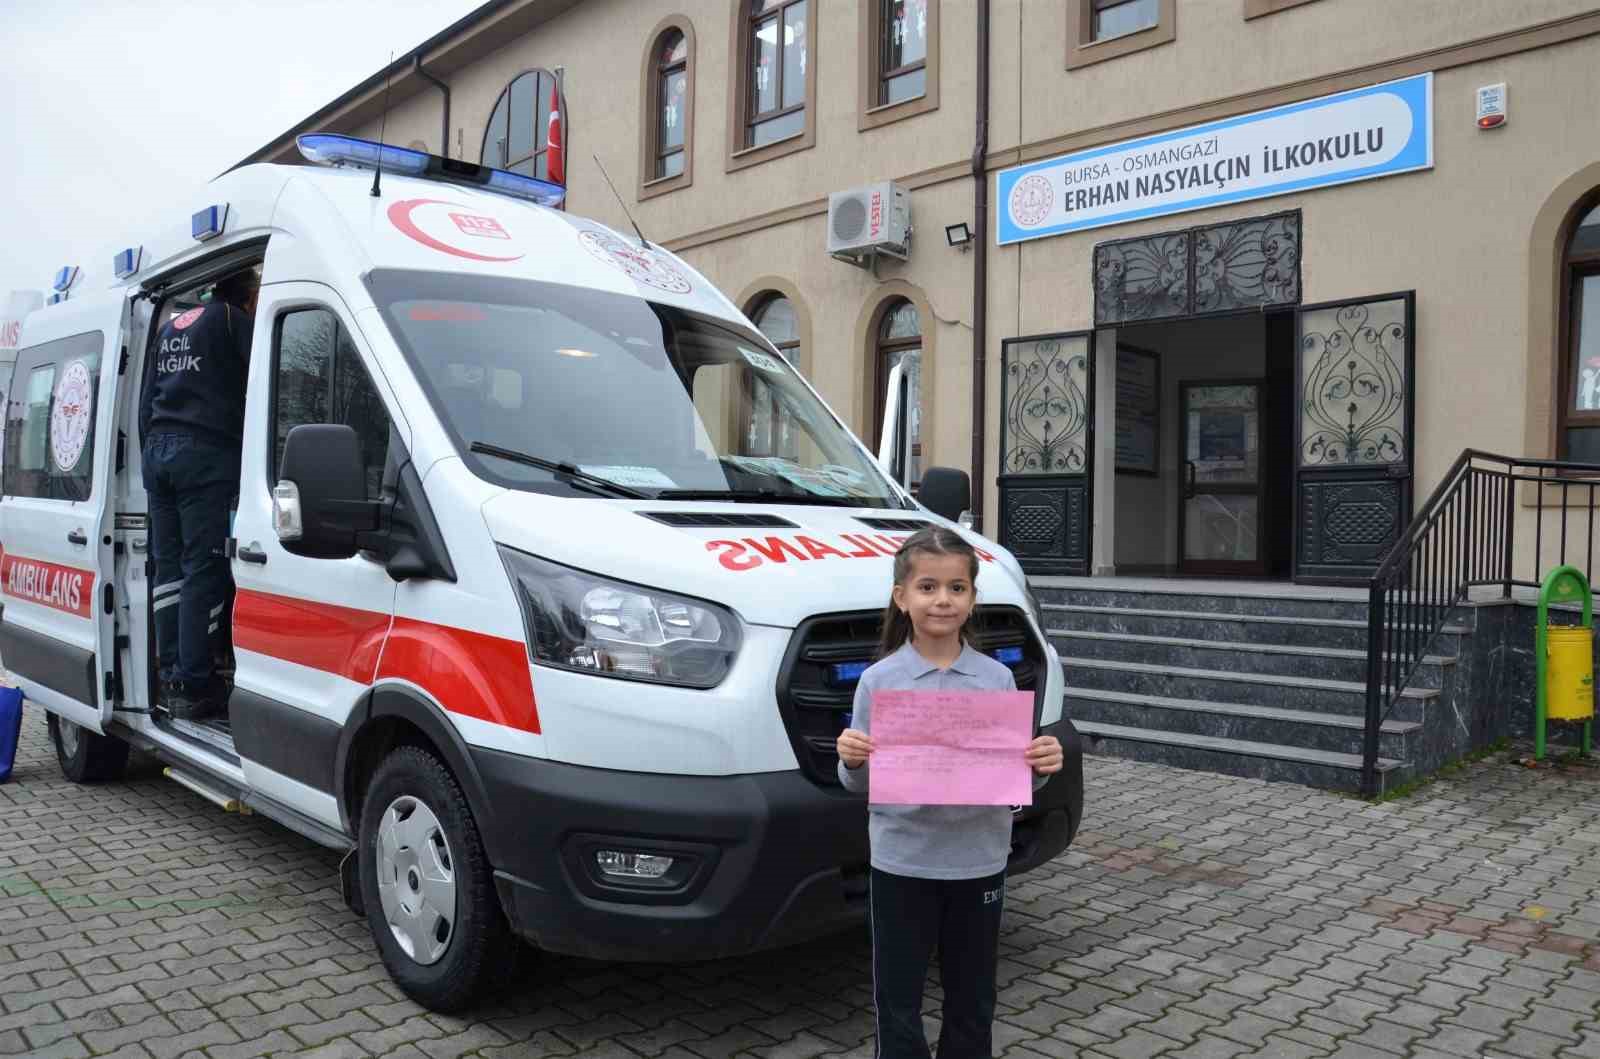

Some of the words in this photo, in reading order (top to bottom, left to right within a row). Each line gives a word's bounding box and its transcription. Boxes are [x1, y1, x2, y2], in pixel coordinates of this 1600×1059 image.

[1065, 163, 1110, 186] BURSA
[1123, 136, 1218, 172] OSMANGAZİ
[1065, 179, 1129, 212] ERHAN
[1135, 155, 1251, 198] NASYALÇIN
[1263, 127, 1383, 173] İLKOKULU
[160, 334, 190, 353] ACİL
[8, 561, 83, 610] AMBULANS
